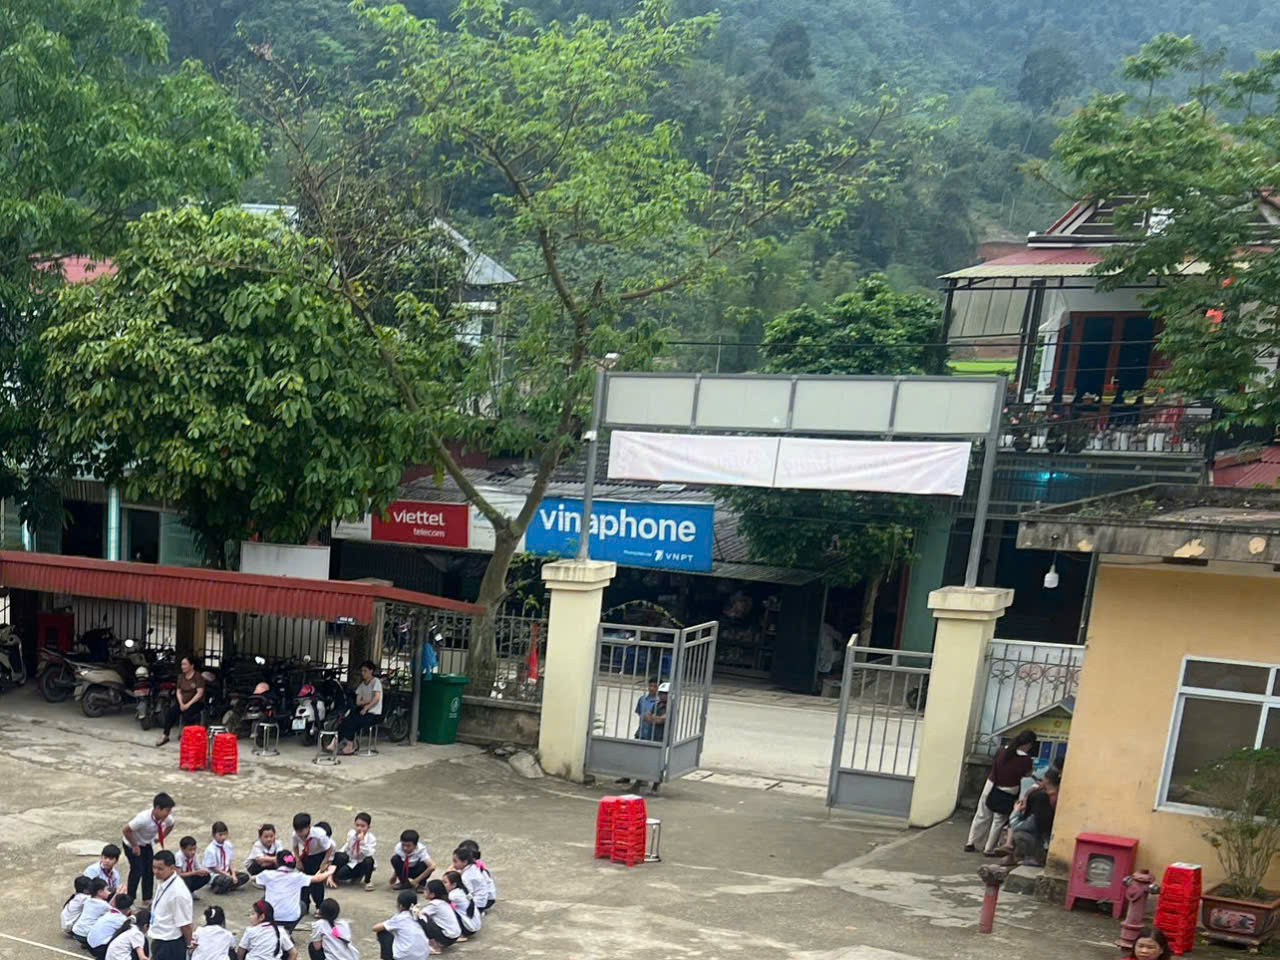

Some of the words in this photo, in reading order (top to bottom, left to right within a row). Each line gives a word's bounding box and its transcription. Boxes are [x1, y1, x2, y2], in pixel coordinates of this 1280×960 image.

[393, 508, 446, 527] viettel
[539, 503, 697, 543] vinaphone
[413, 527, 446, 538] telecom
[665, 552, 694, 562] VNPT
